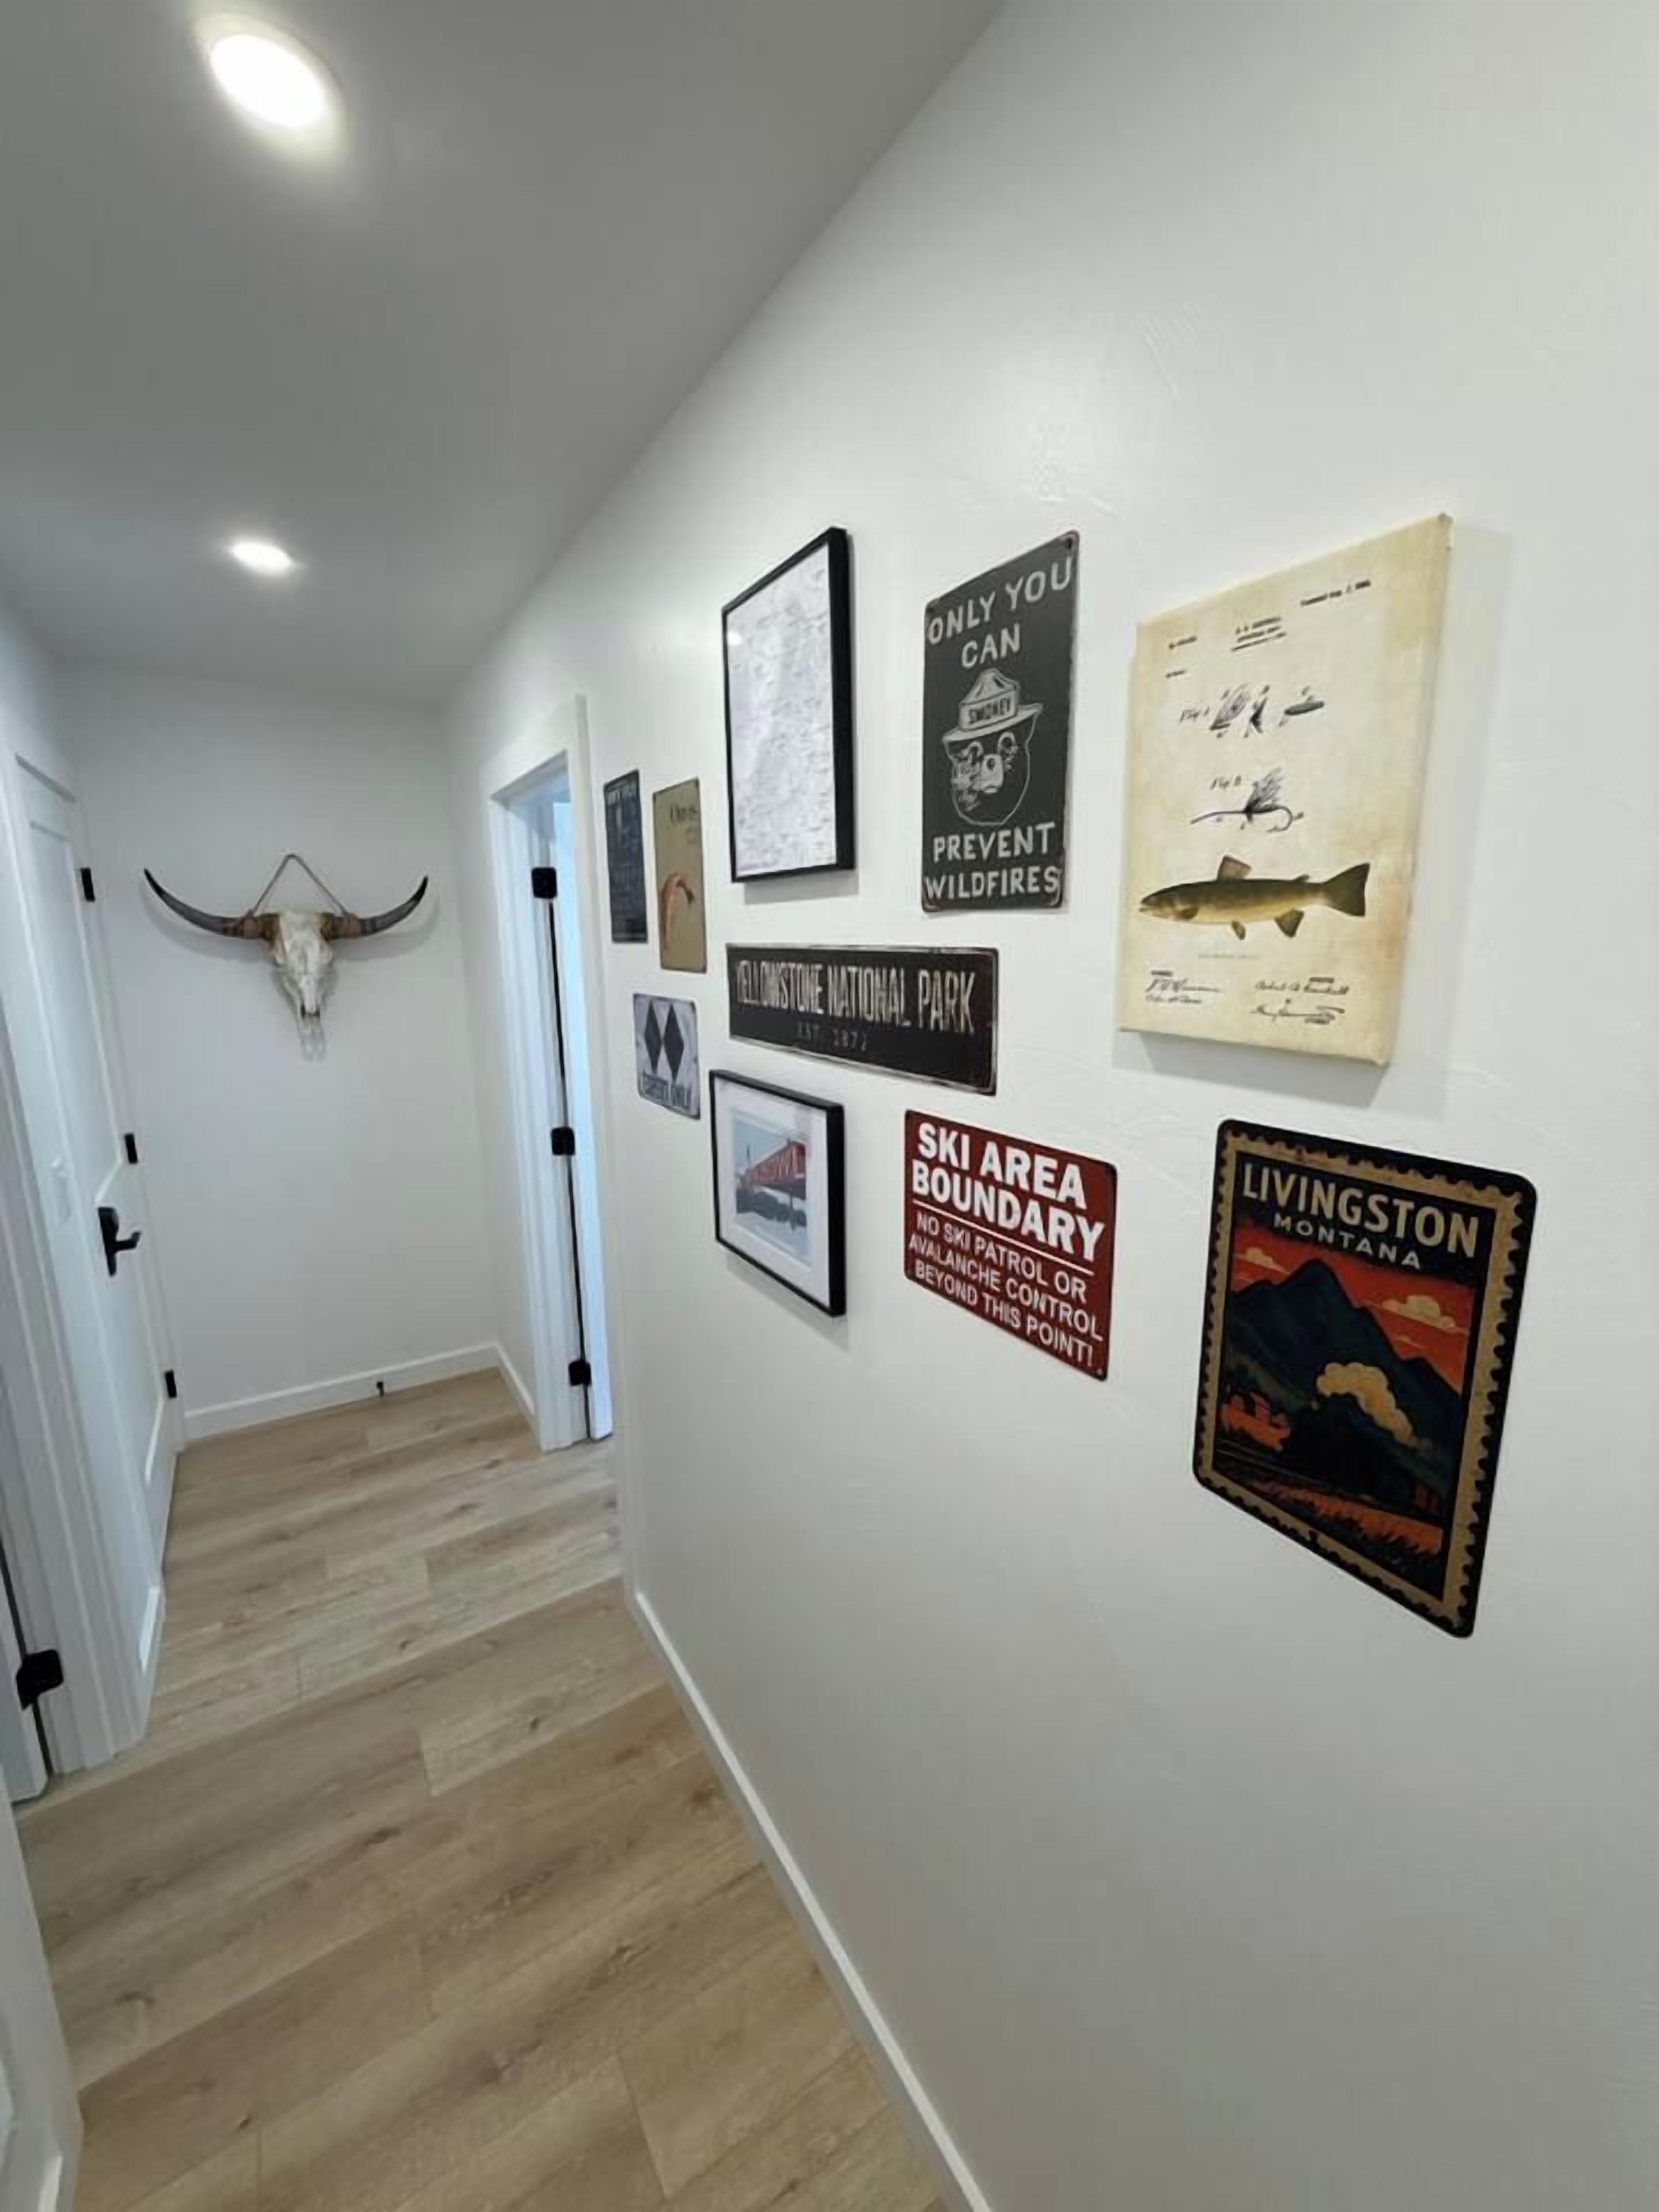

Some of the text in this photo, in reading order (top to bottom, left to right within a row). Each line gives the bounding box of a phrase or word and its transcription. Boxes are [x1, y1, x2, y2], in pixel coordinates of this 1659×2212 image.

[928, 555, 1073, 645] ONLY YOU
[961, 623, 1020, 668] CAN
[933, 821, 1055, 863] PREVENT
[924, 865, 1059, 899] WILDFIRES
[827, 964, 911, 1027] NATIONAL
[918, 969, 976, 1035] PARK
[918, 1122, 1088, 1210] SKI AREA
[912, 1158, 1105, 1262] BOUNDARY
[1242, 1161, 1479, 1259] LIVINGSTON
[1274, 1211, 1421, 1271] MONTANA
[908, 1233, 1104, 1342] AVALANCHE CONTROL
[915, 1259, 979, 1306] BEYOND
[981, 1291, 1021, 1329] THIS
[917, 1211, 1087, 1304] NO SKI PATROL OR
